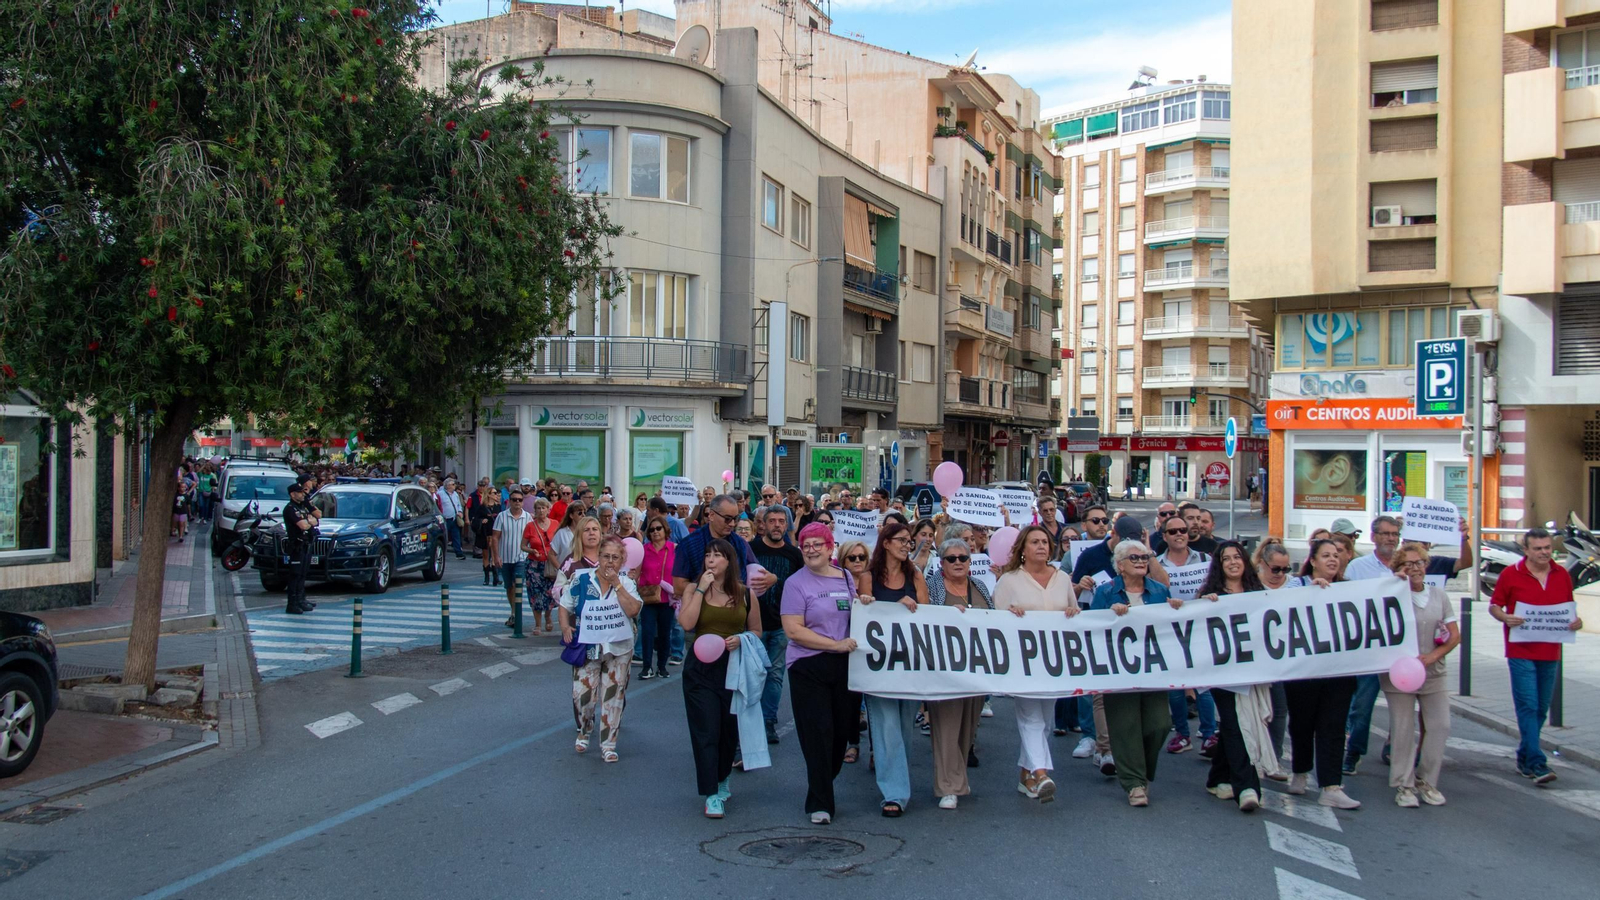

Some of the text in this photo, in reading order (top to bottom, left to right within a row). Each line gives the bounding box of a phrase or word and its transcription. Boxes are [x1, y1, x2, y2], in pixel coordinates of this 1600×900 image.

[1432, 342, 1456, 353] EYSA
[1430, 363, 1452, 397] P
[1430, 402, 1449, 410] LIBRE
[552, 411, 608, 420] vectorsolar
[647, 413, 694, 422] vectorsolar
[1306, 407, 1370, 420] CENTROS
[1138, 439, 1167, 448] Fenicia
[822, 456, 853, 464] MATCH
[1423, 505, 1454, 513] SANIDAD
[1418, 522, 1453, 532] DEFIENDE
[595, 621, 625, 630] DEFIENDE
[866, 596, 1405, 677] SANIDAD PUBLICA Y DE CALIDAD
